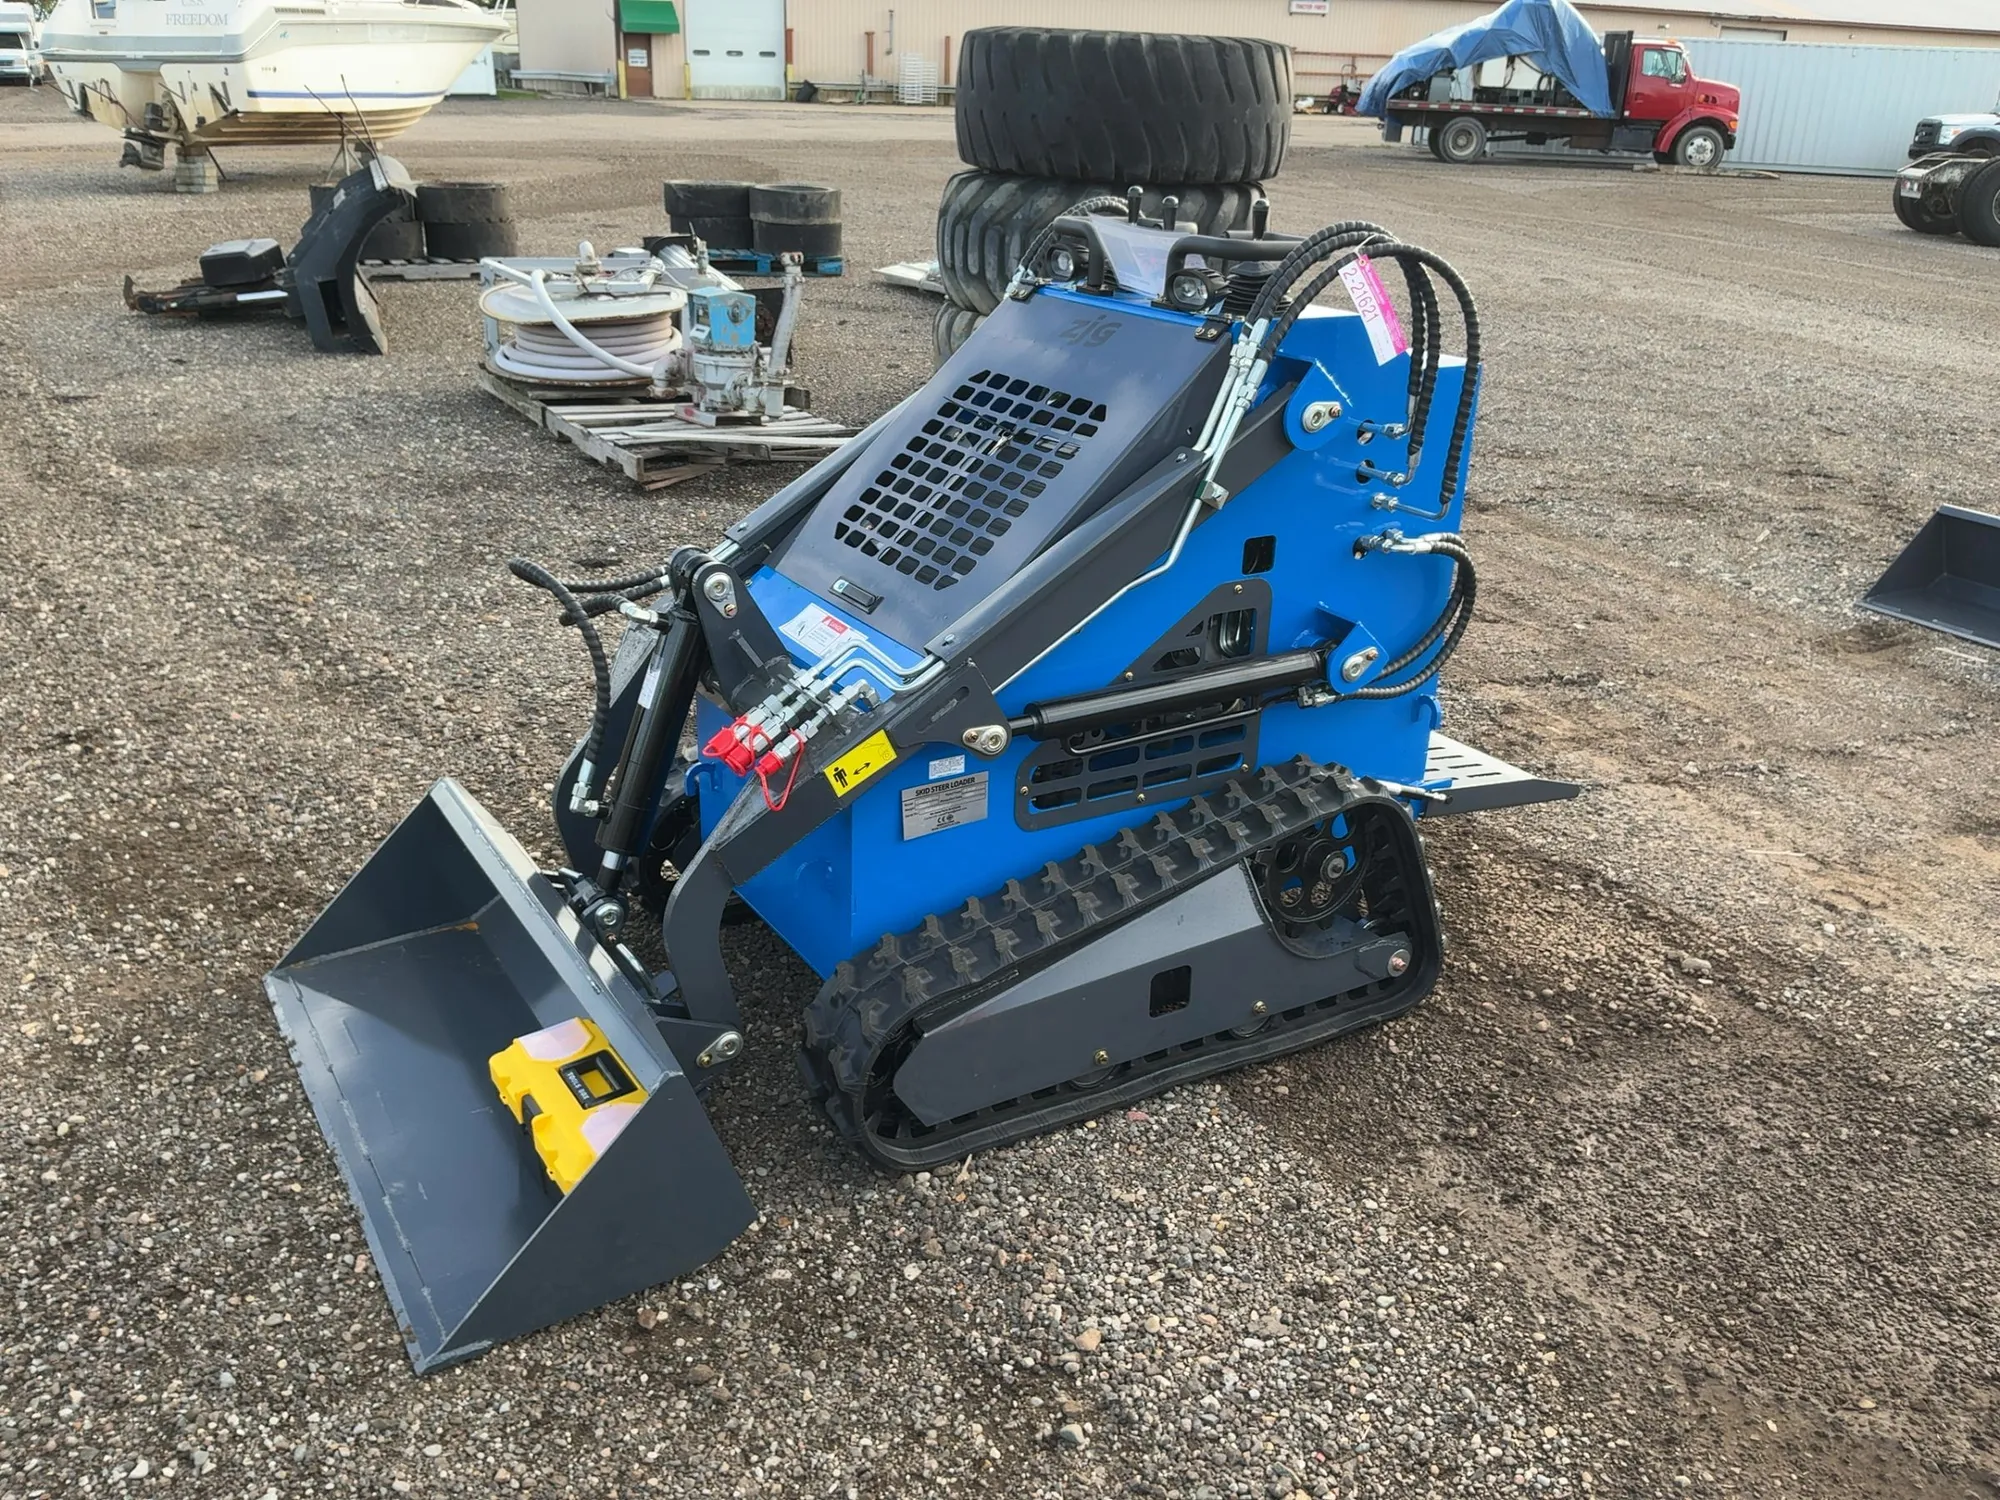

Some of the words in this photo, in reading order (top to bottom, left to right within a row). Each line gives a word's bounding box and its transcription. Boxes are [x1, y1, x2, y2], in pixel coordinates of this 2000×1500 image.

[165, 13, 228, 25] FREEDOM
[1343, 267, 1379, 322] 2-21621
[915, 786, 931, 797] SKID
[931, 783, 950, 793] STEER
[950, 776, 976, 789] LOADER
